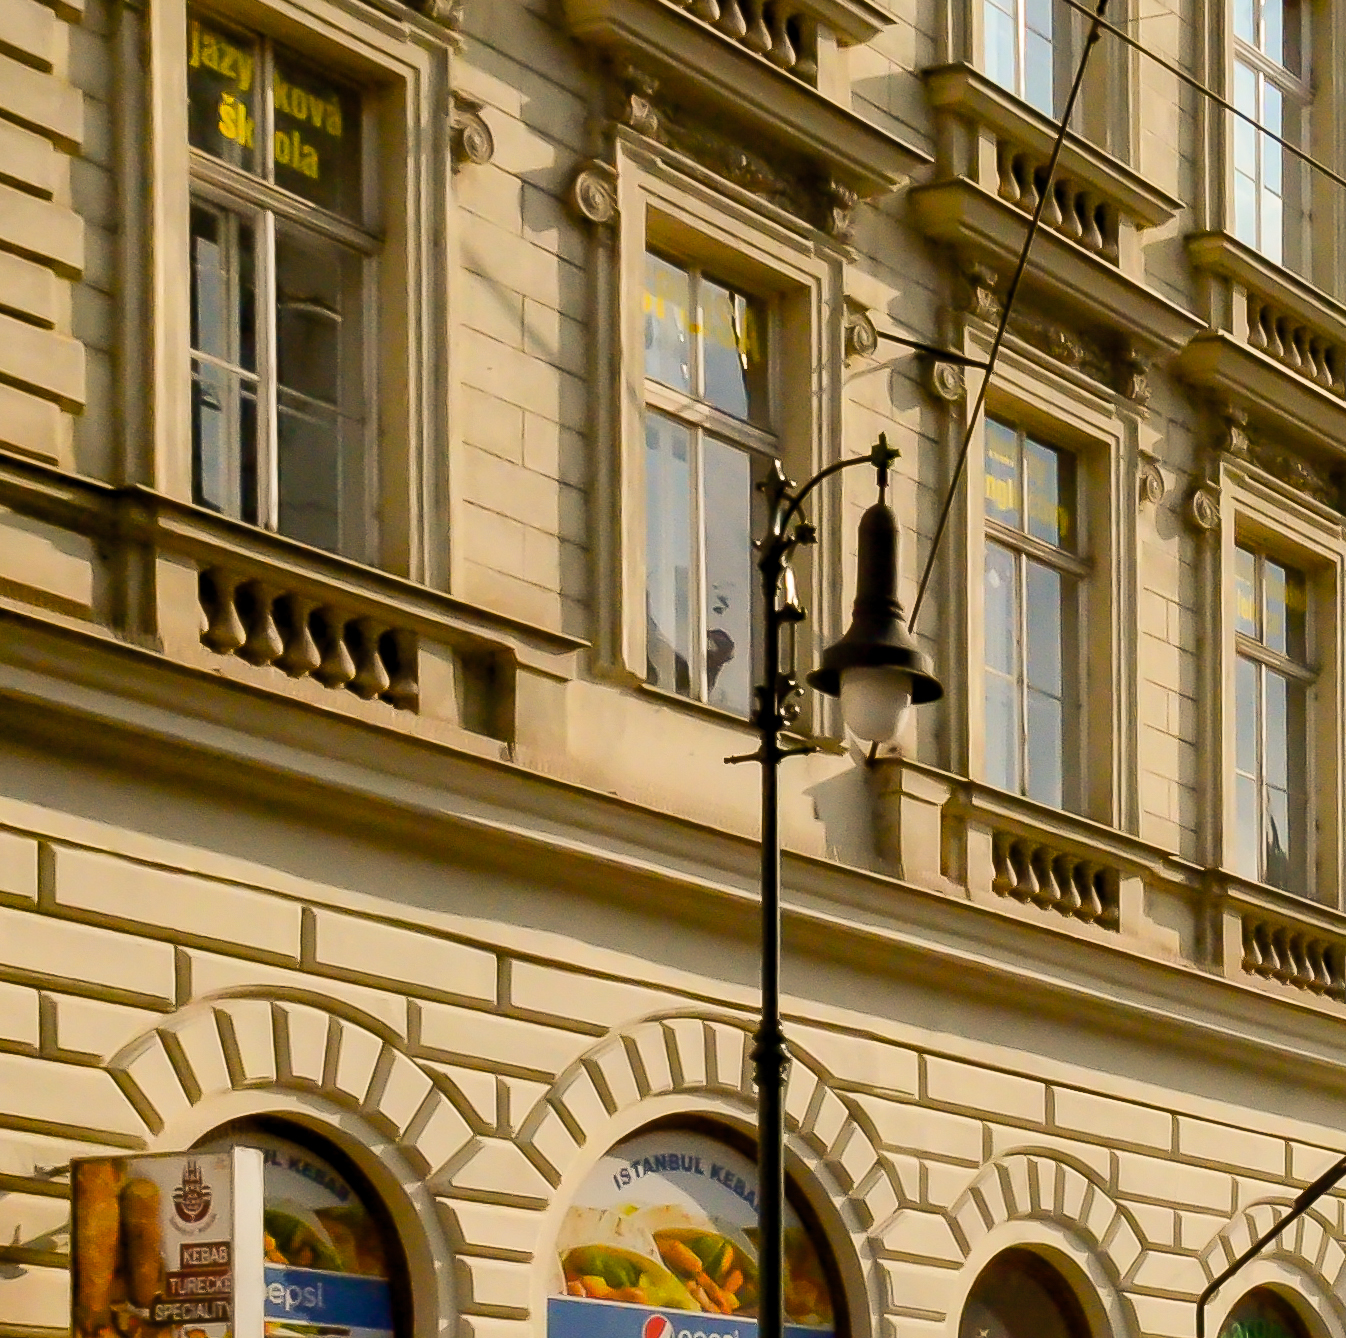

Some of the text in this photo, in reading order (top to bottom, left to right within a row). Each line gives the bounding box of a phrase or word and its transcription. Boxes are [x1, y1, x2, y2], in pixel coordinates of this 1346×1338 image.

[613, 1152, 760, 1216] ISTANBUL KEBA
[182, 1246, 230, 1265] KEBAB
[263, 1282, 325, 1312] epsi
